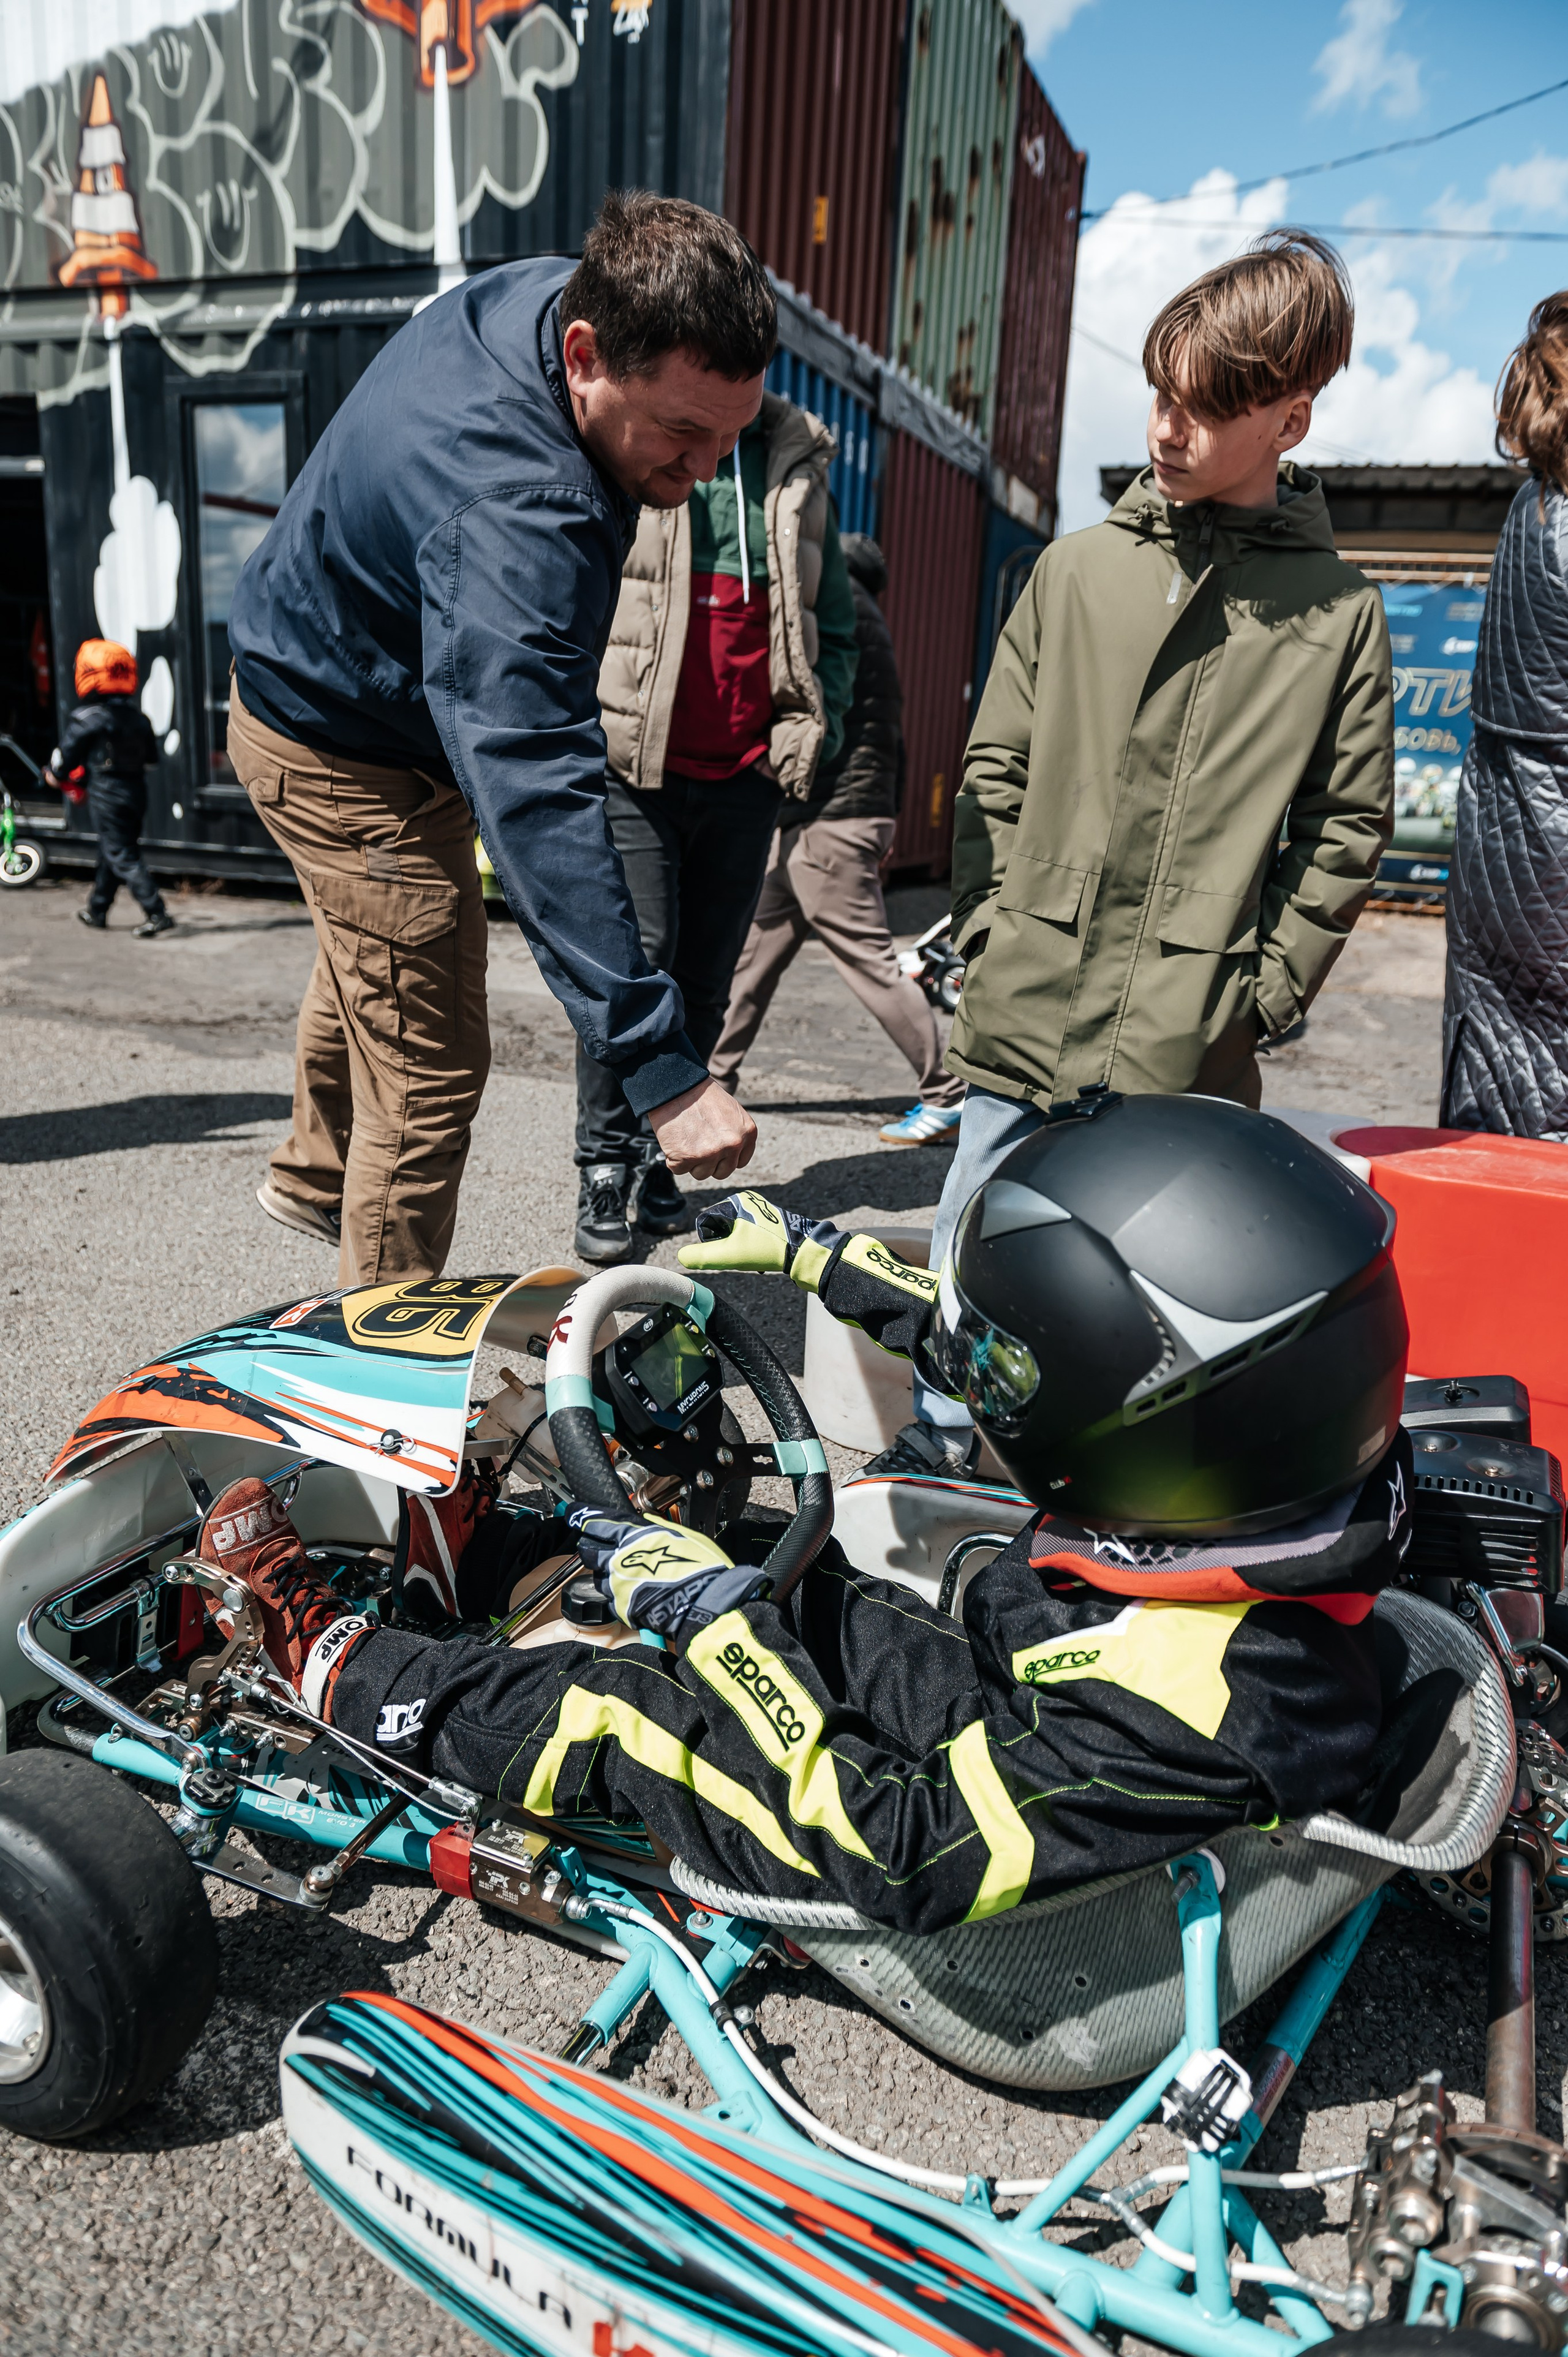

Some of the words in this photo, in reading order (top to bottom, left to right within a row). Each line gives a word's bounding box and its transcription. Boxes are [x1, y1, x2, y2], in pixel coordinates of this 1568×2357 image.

[866, 1250, 938, 1292] parco
[321, 1621, 364, 1661] OMP
[1024, 1650, 1101, 1684] sparco
[722, 1642, 805, 1743] sparco
[318, 1810, 366, 1825] MONSTER
[347, 2146, 572, 2329] FORMULA
